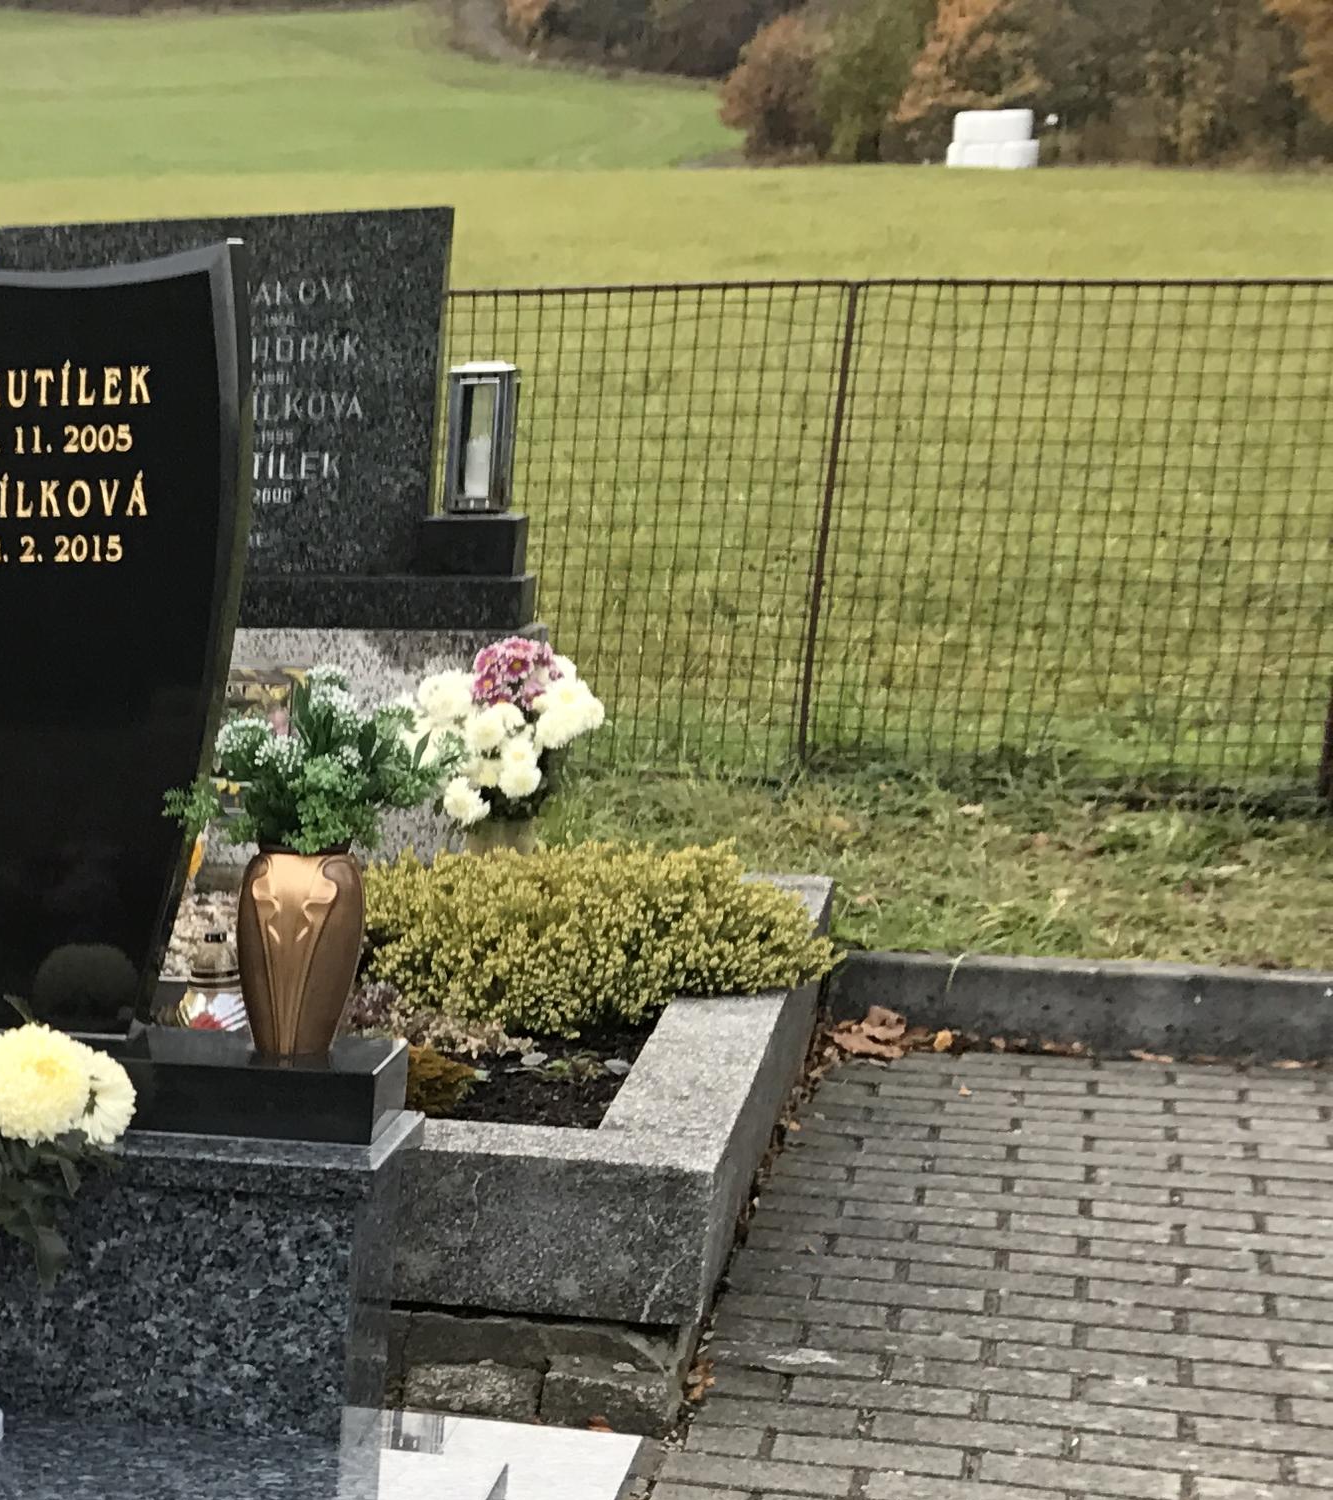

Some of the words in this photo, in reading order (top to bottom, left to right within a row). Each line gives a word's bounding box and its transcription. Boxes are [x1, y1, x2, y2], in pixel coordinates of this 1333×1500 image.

[14, 425, 53, 454] 11.
[63, 423, 133, 455] 2005
[19, 535, 43, 563] 2.
[54, 534, 123, 562] 2015
